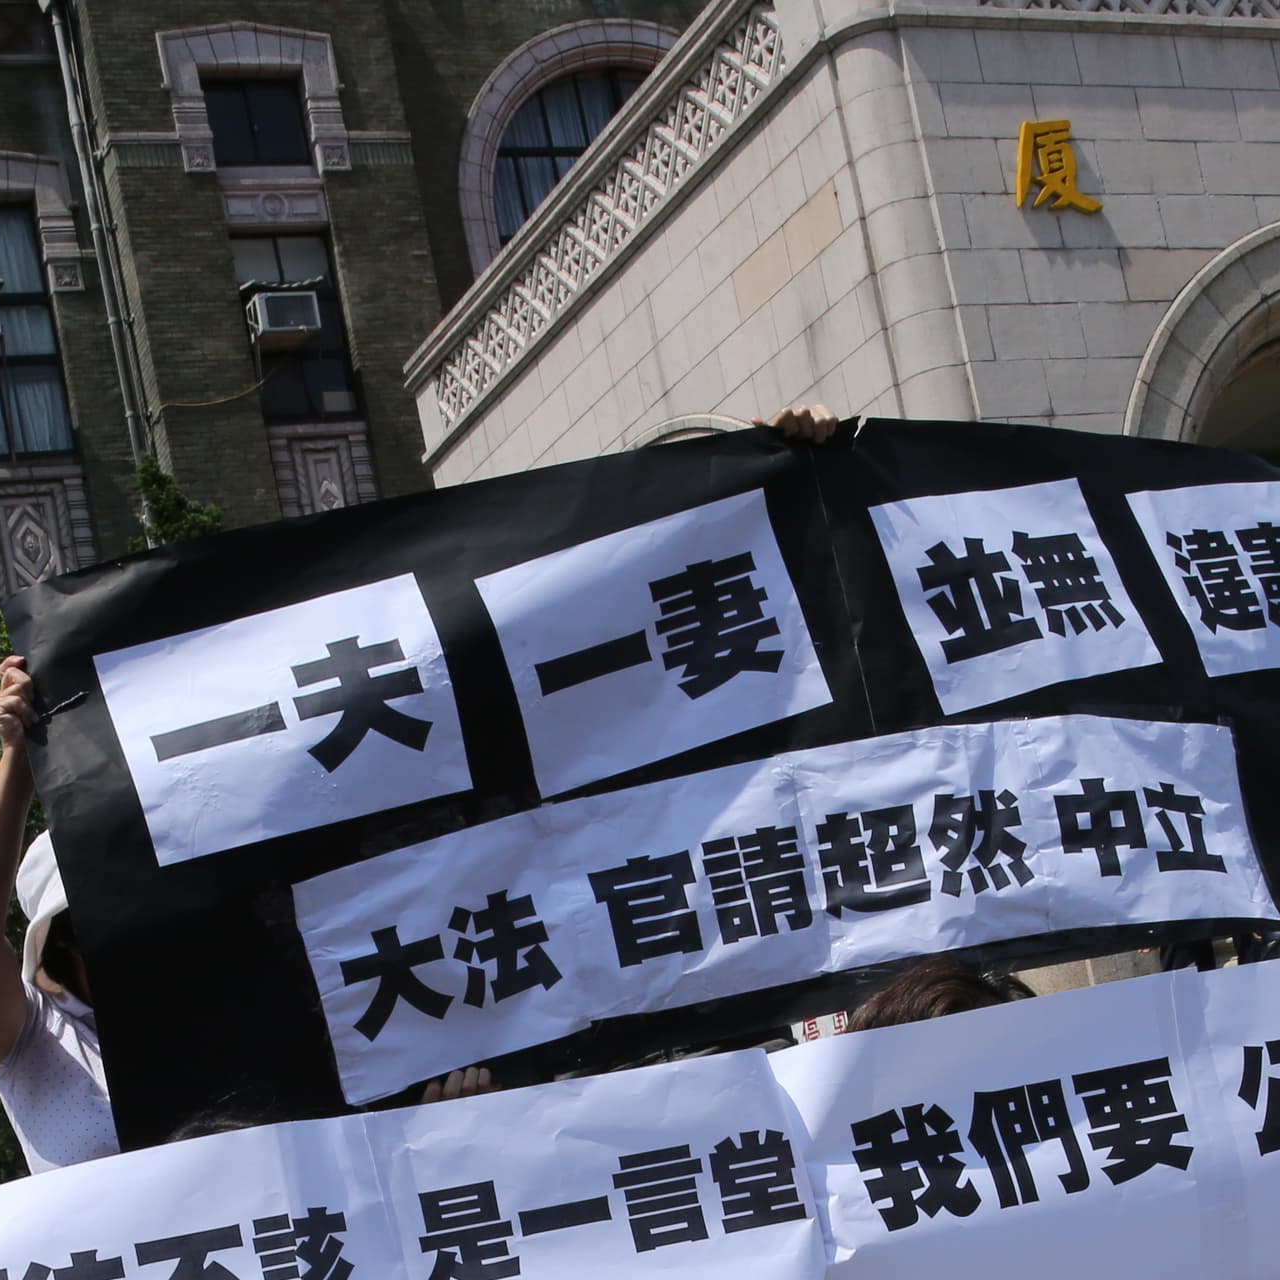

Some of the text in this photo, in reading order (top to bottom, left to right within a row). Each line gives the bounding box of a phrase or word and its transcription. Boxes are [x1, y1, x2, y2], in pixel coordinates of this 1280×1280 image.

[151, 636, 433, 773] 一夫
[534, 551, 784, 699] 一妻
[917, 531, 1124, 664] 並無
[851, 1057, 1194, 1231] 我們要
